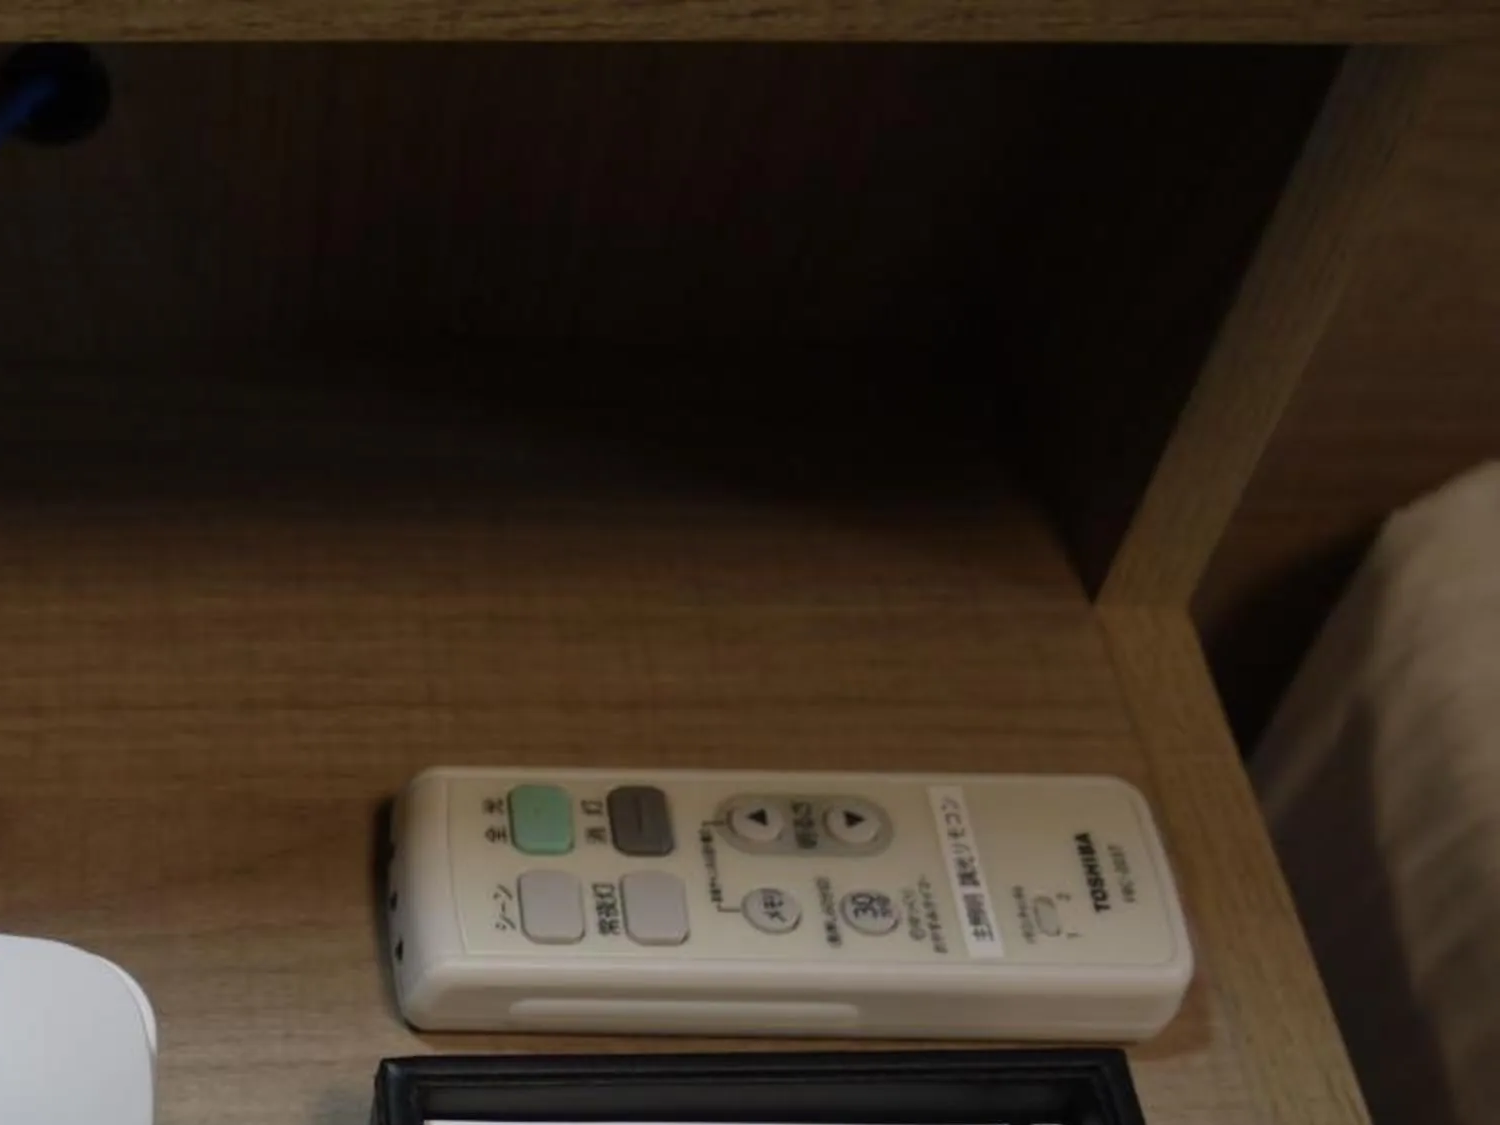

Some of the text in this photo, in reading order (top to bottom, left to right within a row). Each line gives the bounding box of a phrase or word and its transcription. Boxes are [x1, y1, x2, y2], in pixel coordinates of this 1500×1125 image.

[1074, 832, 1111, 912] TOSHIBA
[493, 884, 516, 930] シーン
